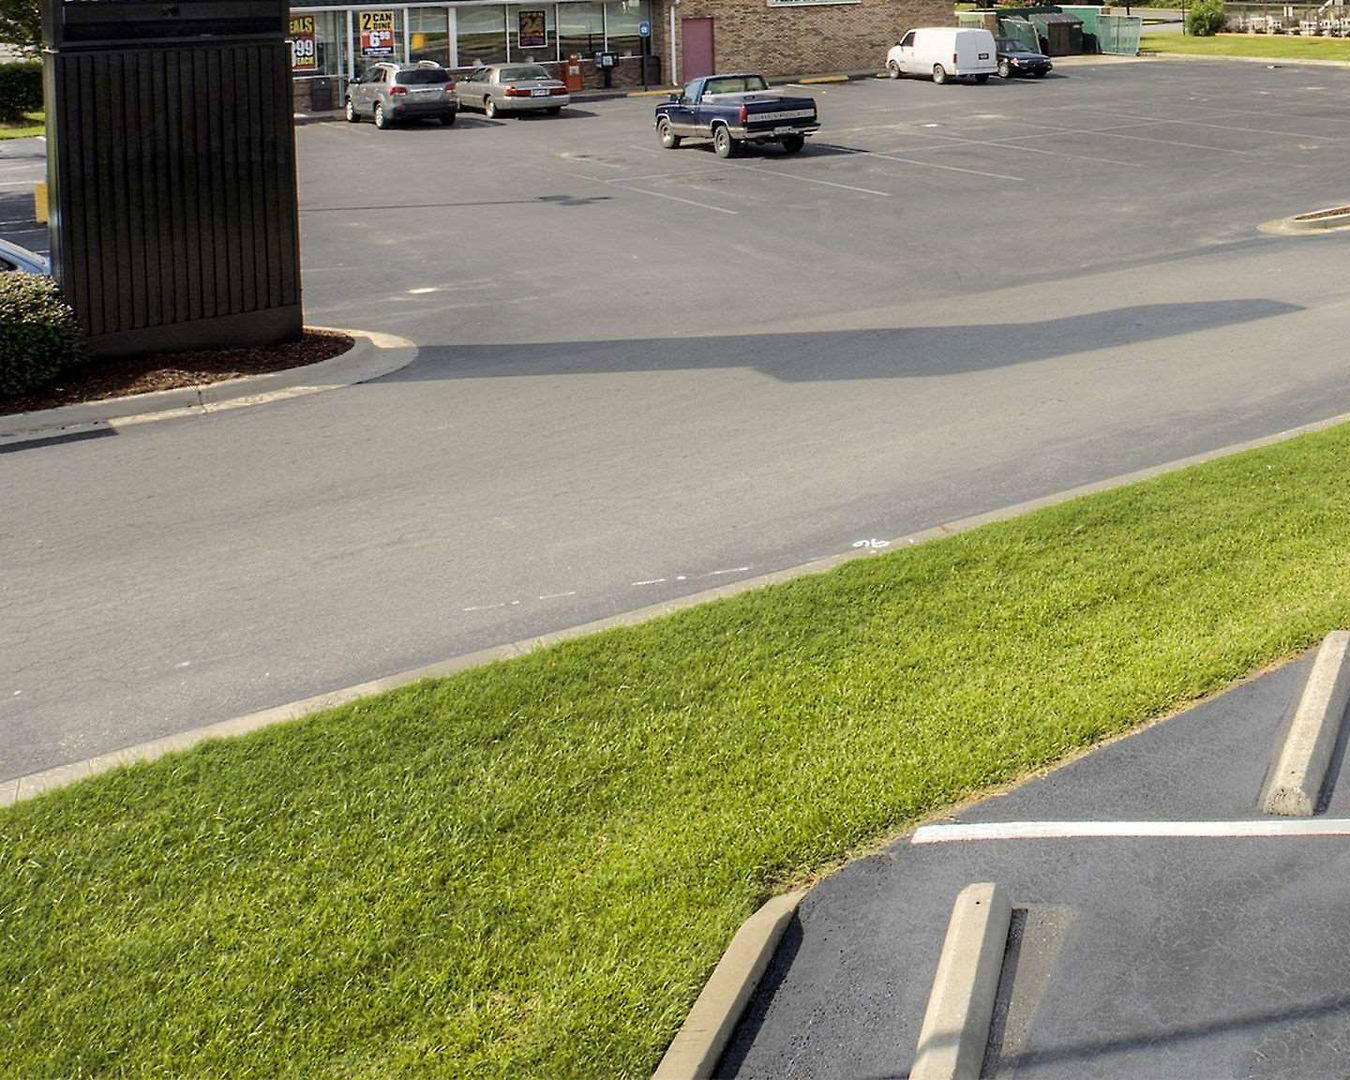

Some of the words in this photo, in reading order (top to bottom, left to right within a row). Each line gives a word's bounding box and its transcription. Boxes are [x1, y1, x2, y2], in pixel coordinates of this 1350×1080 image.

[290, 17, 313, 33] EALS
[362, 13, 371, 30] 2
[373, 13, 392, 21] CAN
